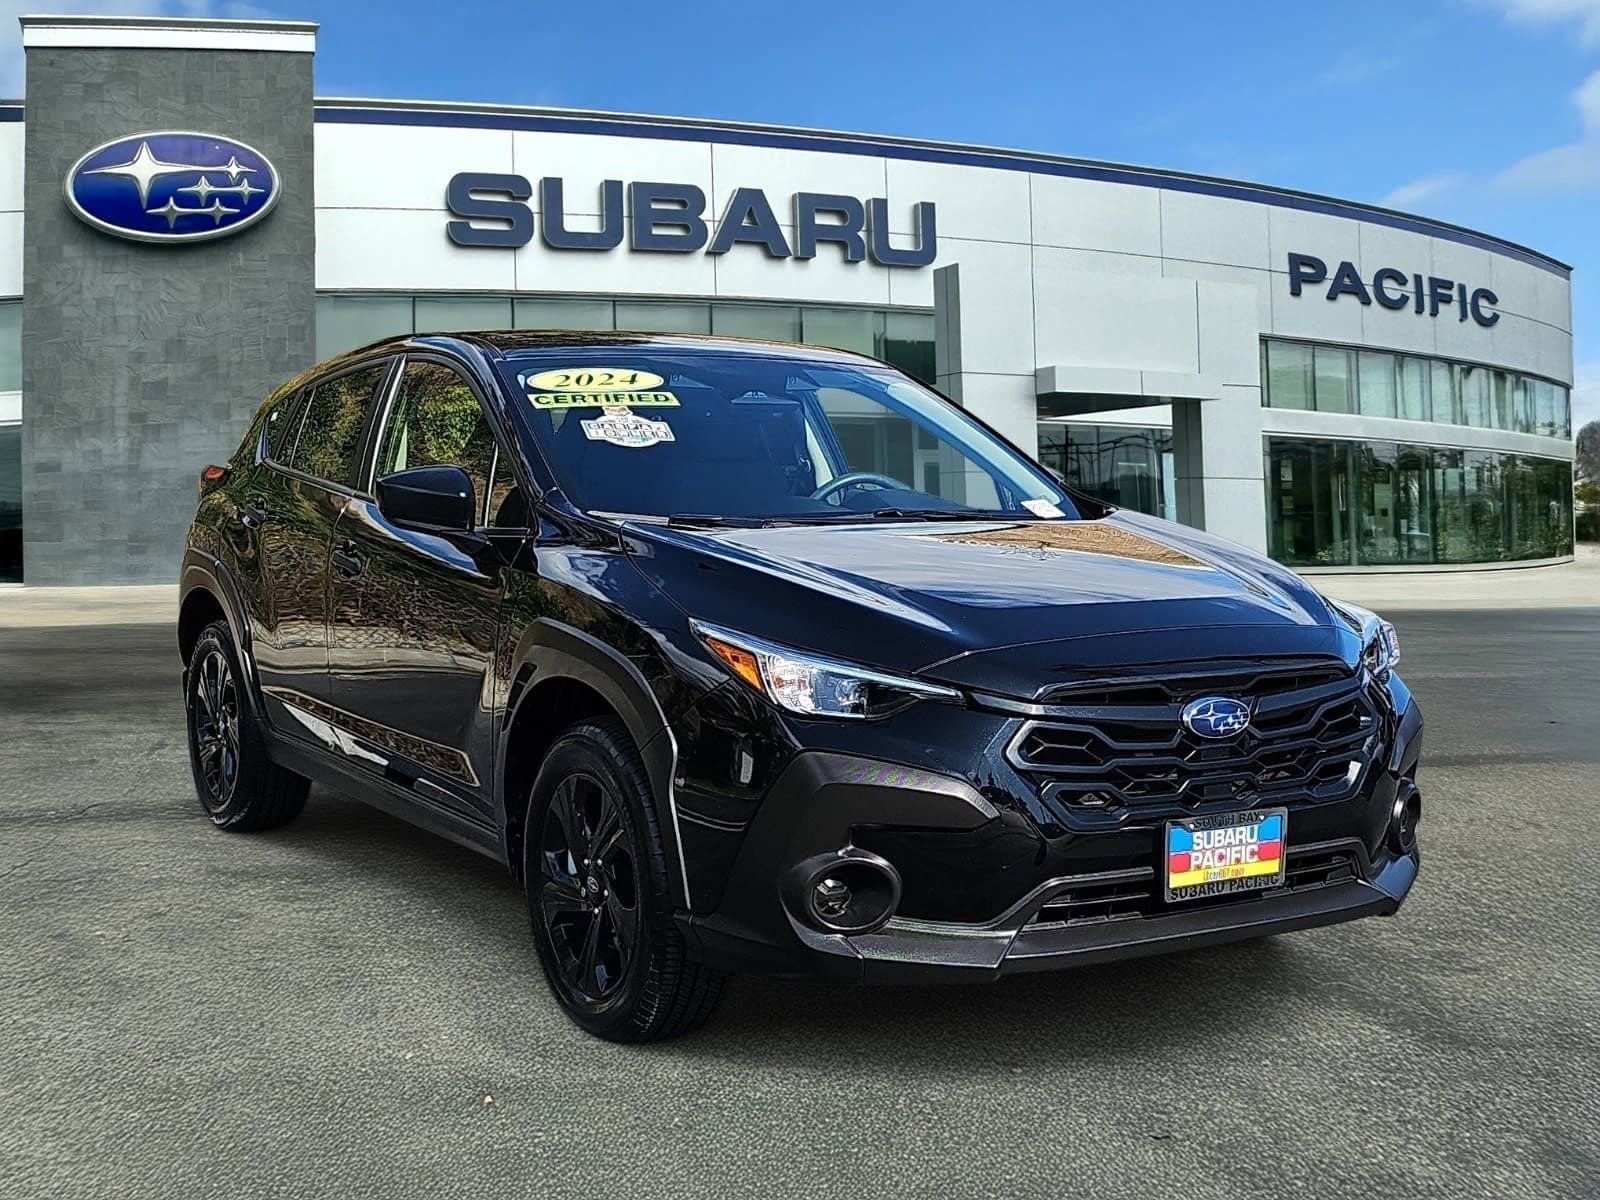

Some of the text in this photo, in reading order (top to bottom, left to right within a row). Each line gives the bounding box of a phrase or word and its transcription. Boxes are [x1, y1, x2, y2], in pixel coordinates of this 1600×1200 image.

[446, 171, 937, 268] SUBARU
[1287, 252, 1500, 327] PACIFIC
[553, 372, 639, 388] 2024
[534, 393, 671, 405] CERTIFIED
[1194, 811, 1261, 828] SOUTH BAY
[1192, 825, 1259, 851] SUBARU
[1190, 843, 1259, 871] PACIFIC
[1170, 875, 1280, 900] SUBARU PACIFIC
